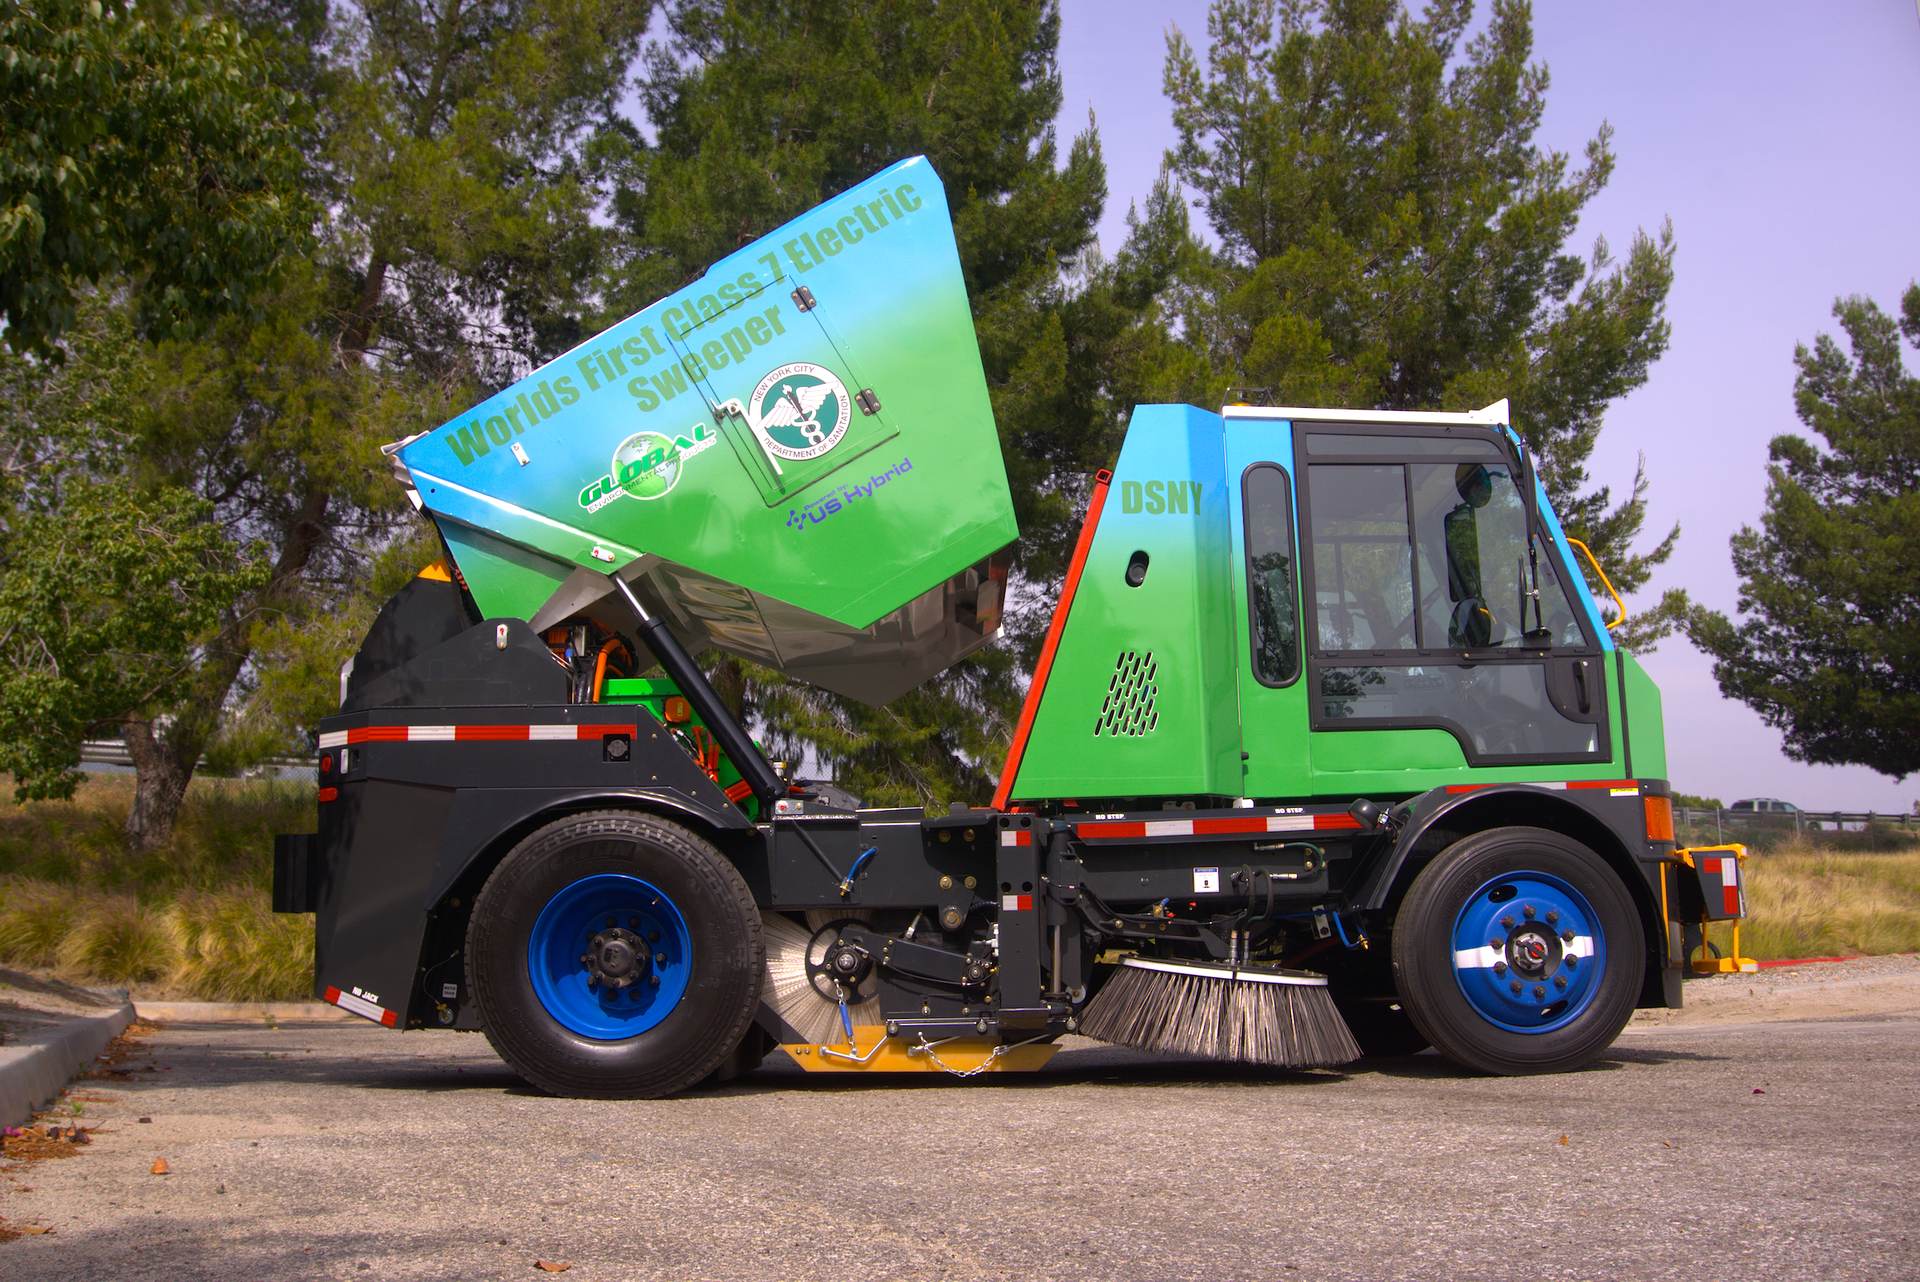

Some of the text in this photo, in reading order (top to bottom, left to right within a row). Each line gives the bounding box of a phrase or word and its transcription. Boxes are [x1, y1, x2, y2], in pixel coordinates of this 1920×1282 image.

[445, 184, 922, 467] Worlds First Class 7 Electric
[626, 303, 786, 413] Sweeper
[754, 365, 815, 402] NEW YORK CITY
[764, 395, 848, 458] DEPARTMENT OF SANITATION
[580, 424, 715, 506] GLOBAL
[588, 438, 716, 512] ENVIRONMENTAL PRODUCTS
[808, 457, 913, 523] US Hybrid
[804, 490, 836, 511] Powered
[1121, 480, 1202, 515] DSNY
[352, 986, 379, 1003] NO JACK
